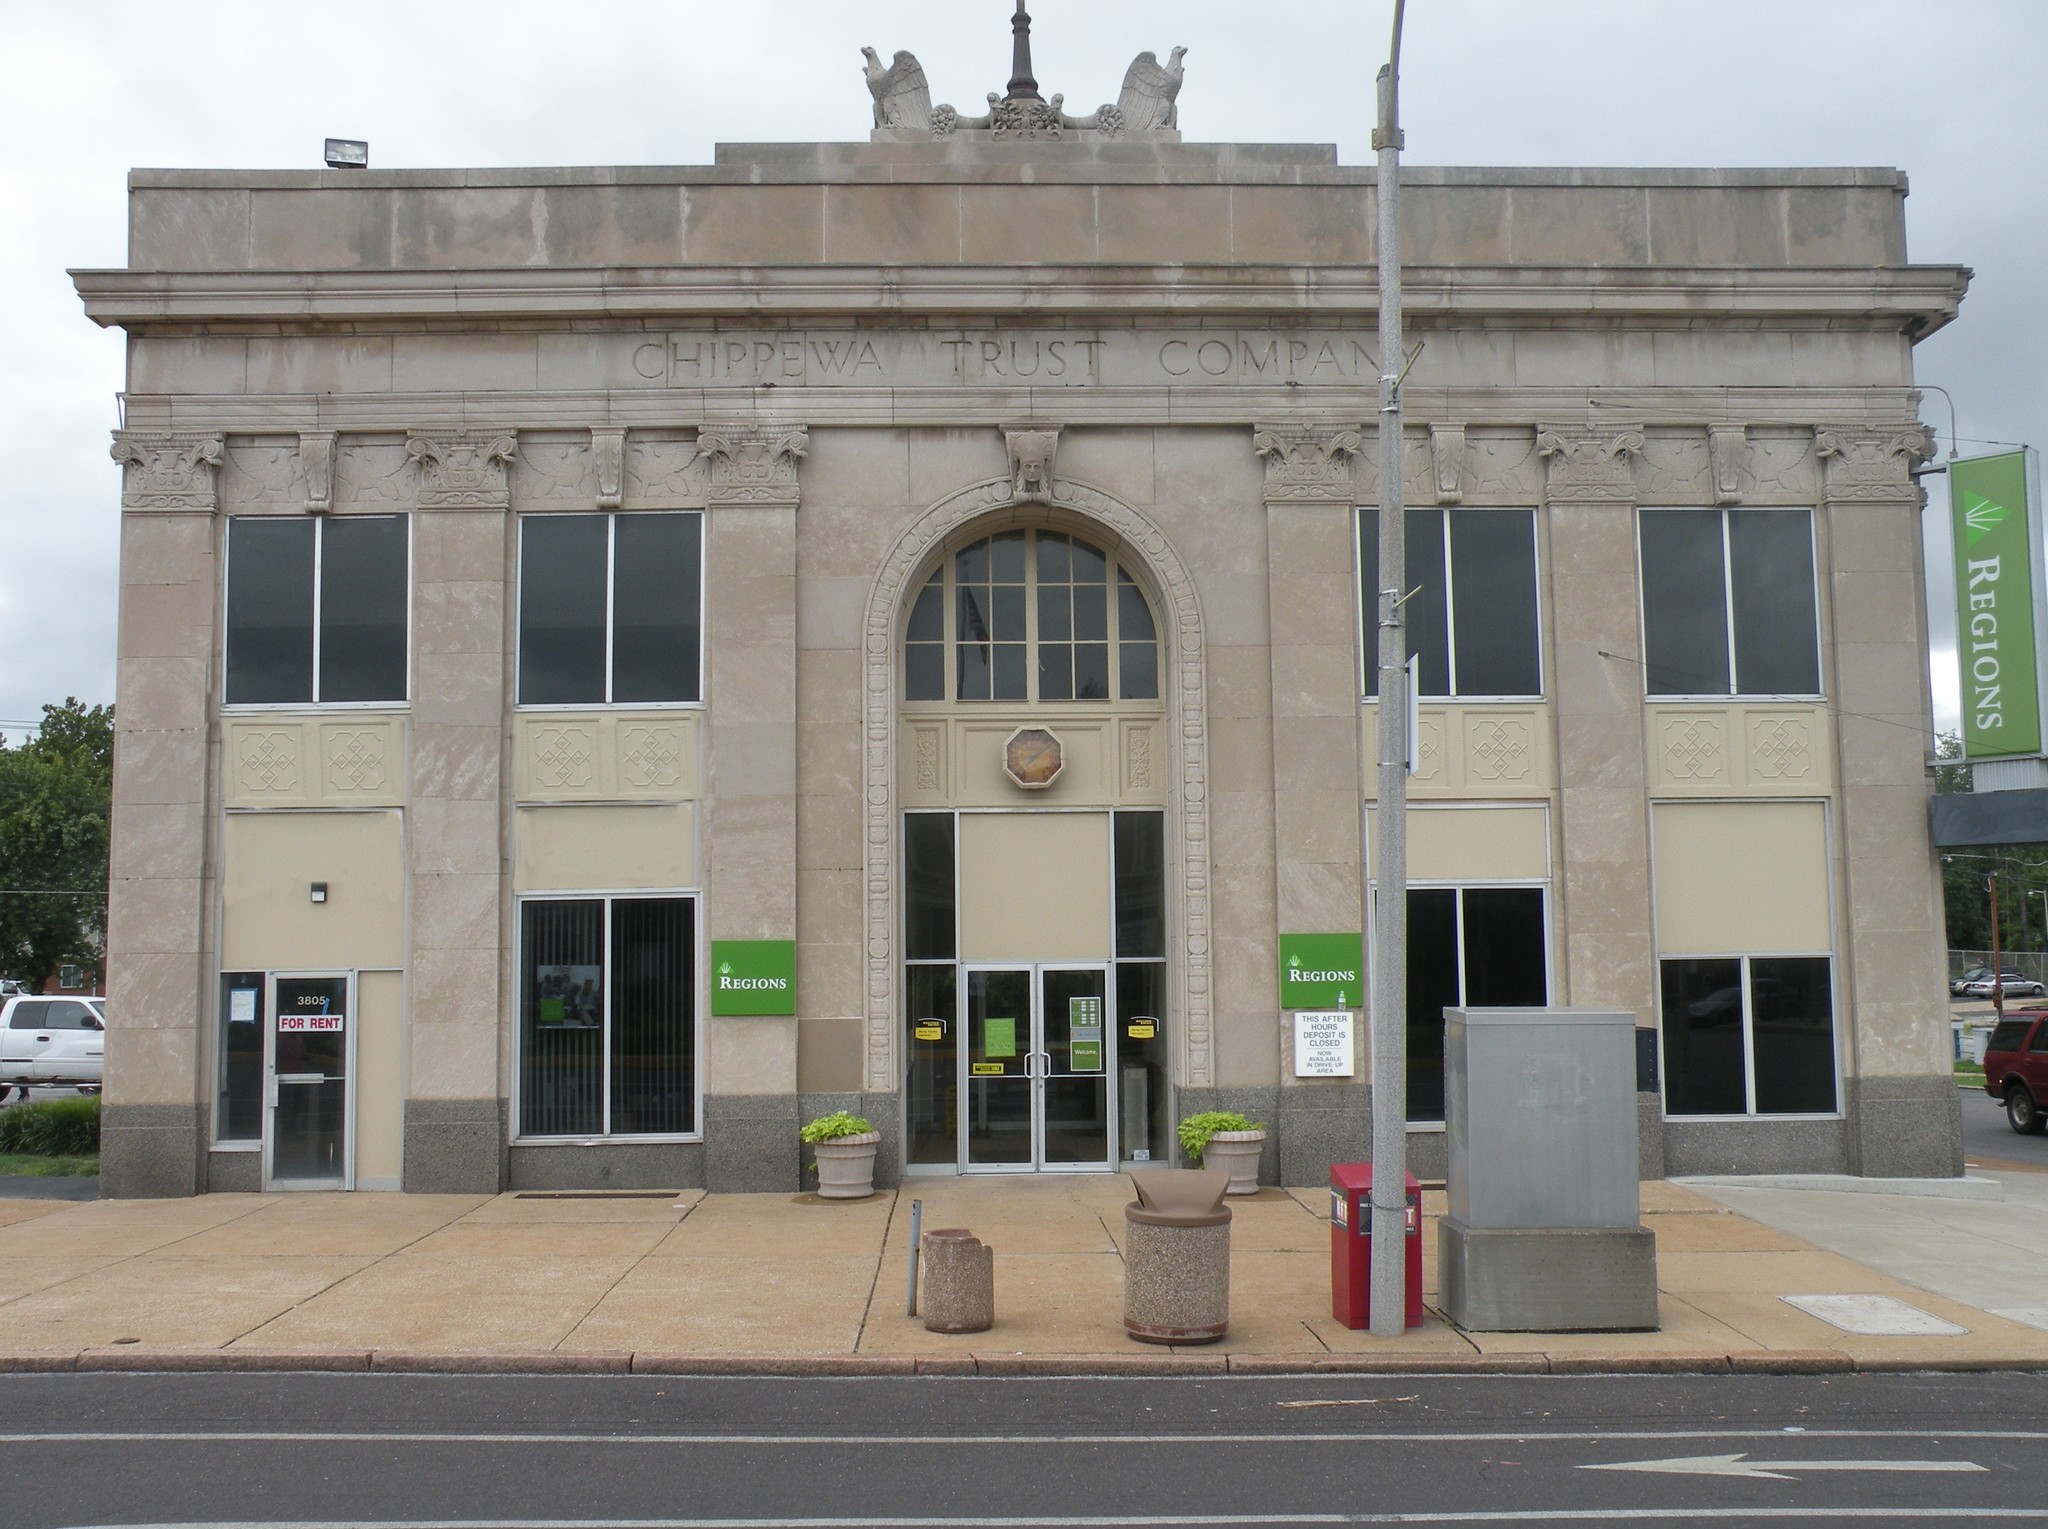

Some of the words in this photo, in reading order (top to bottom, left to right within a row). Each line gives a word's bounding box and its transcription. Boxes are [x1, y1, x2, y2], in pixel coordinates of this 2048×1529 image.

[632, 340, 886, 379] CHIPPEWA
[941, 340, 1107, 377] TRUST
[1967, 554, 2003, 730] REGIONS
[1289, 968, 1355, 982] REGIONS
[719, 975, 787, 990] REGIONS
[297, 995, 326, 1006] 3805
[281, 1017, 305, 1029] FOR
[309, 1017, 341, 1029] RENT
